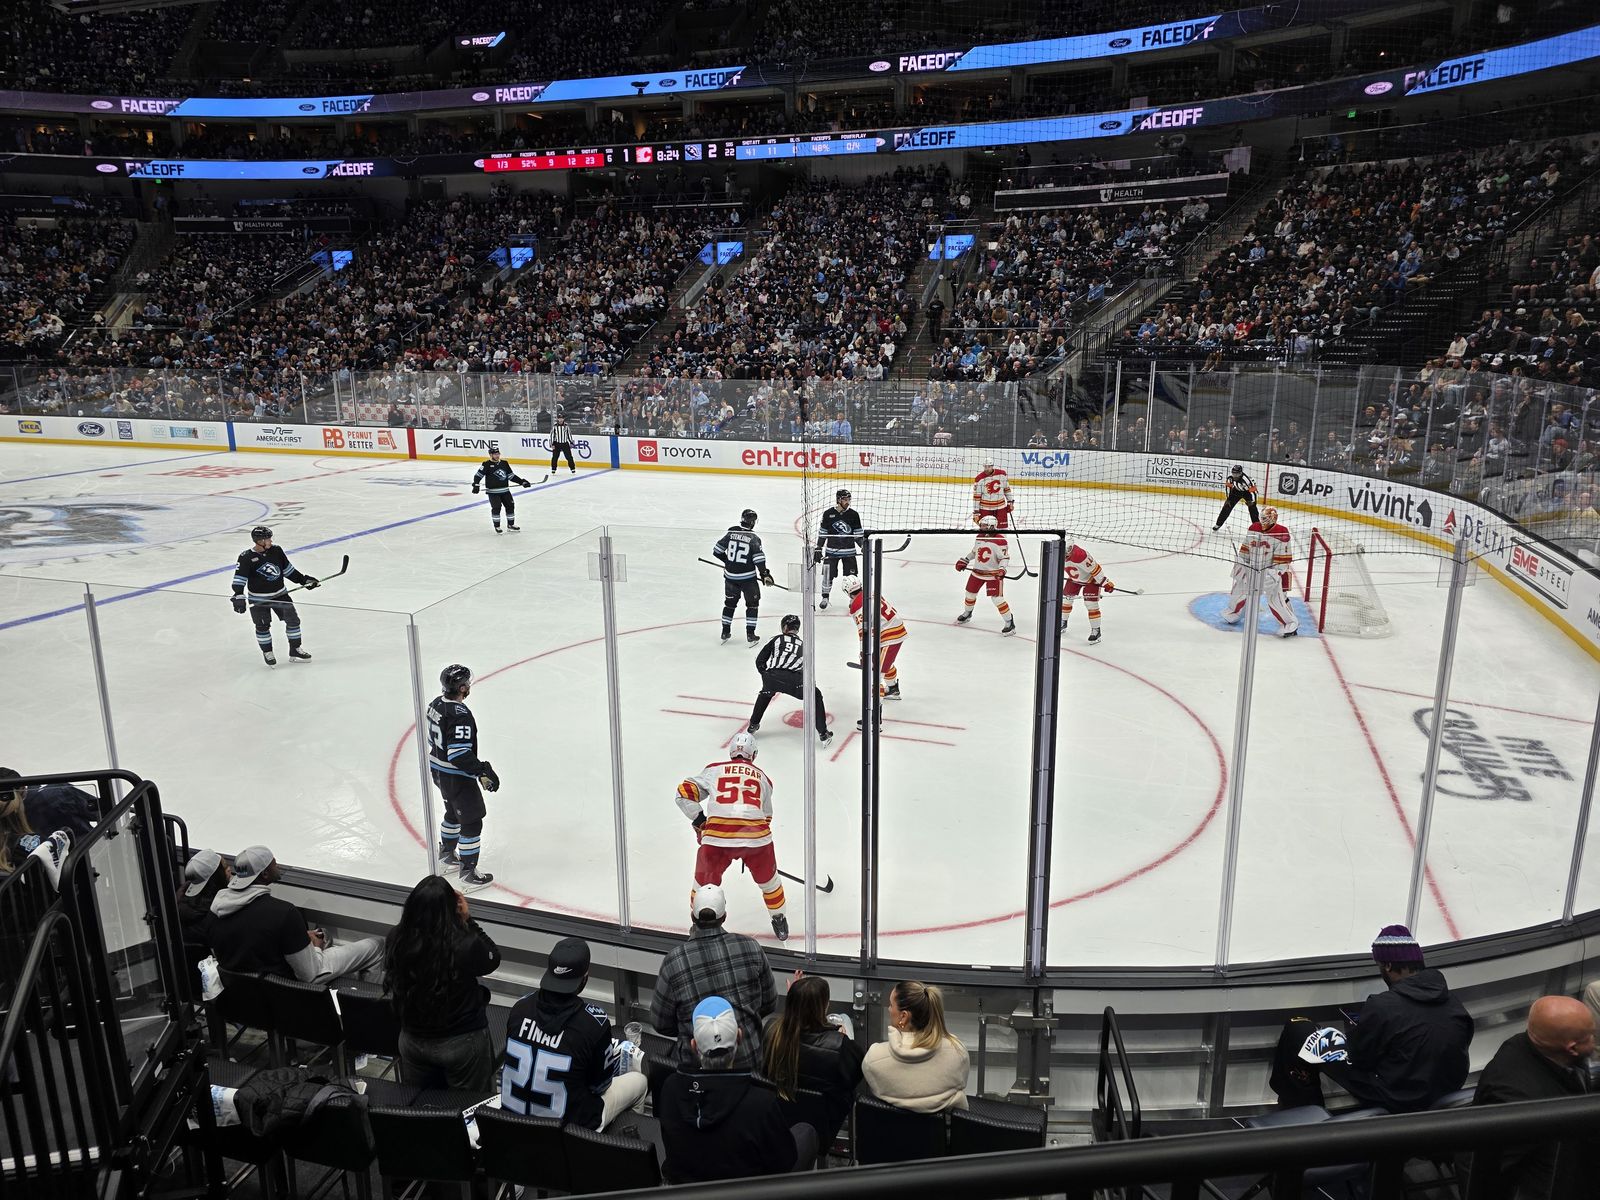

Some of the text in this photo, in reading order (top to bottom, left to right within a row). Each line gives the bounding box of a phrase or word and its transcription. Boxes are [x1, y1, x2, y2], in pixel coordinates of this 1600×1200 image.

[1142, 25, 1214, 46] FACEOFF
[899, 52, 963, 71] FACEOFF
[685, 72, 741, 88] FACEOFF
[1404, 58, 1486, 91] FACEOFF
[495, 86, 546, 102] FACEOFF
[121, 100, 180, 113] FACEOFF
[322, 99, 371, 112] FACEOFF
[1132, 107, 1204, 130] FACEOFF
[894, 131, 956, 148] FACEOFF
[623, 148, 629, 162] 1
[657, 150, 679, 162] 8:24
[708, 144, 717, 158] 2
[768, 147, 777, 155] 11
[585, 157, 595, 165] 23
[125, 162, 185, 176] FACEOFF
[326, 163, 374, 175] FACEOFF
[1114, 188, 1144, 198] HEALTH
[20, 423, 41, 431] IKEA
[82, 423, 101, 435] Ford
[347, 431, 373, 440] PEANUT
[348, 440, 374, 449] BETTER
[445, 438, 499, 449] FILEVINE
[661, 446, 712, 458] TOYOTA
[741, 446, 837, 469] entrata
[876, 455, 911, 464] HEALTH
[1151, 457, 1176, 467] JUST
[1151, 466, 1224, 481] INGREDIENTS
[1463, 513, 1505, 559] DELTA
[727, 540, 750, 564] 82
[1512, 546, 1539, 577] SME
[1539, 565, 1566, 593] STEEL
[784, 642, 798, 653] 91
[455, 725, 472, 740] 53
[715, 776, 762, 810] 52
[518, 1017, 565, 1049] FINAU
[1304, 1031, 1321, 1052] UTAH
[501, 1037, 572, 1119] 25
